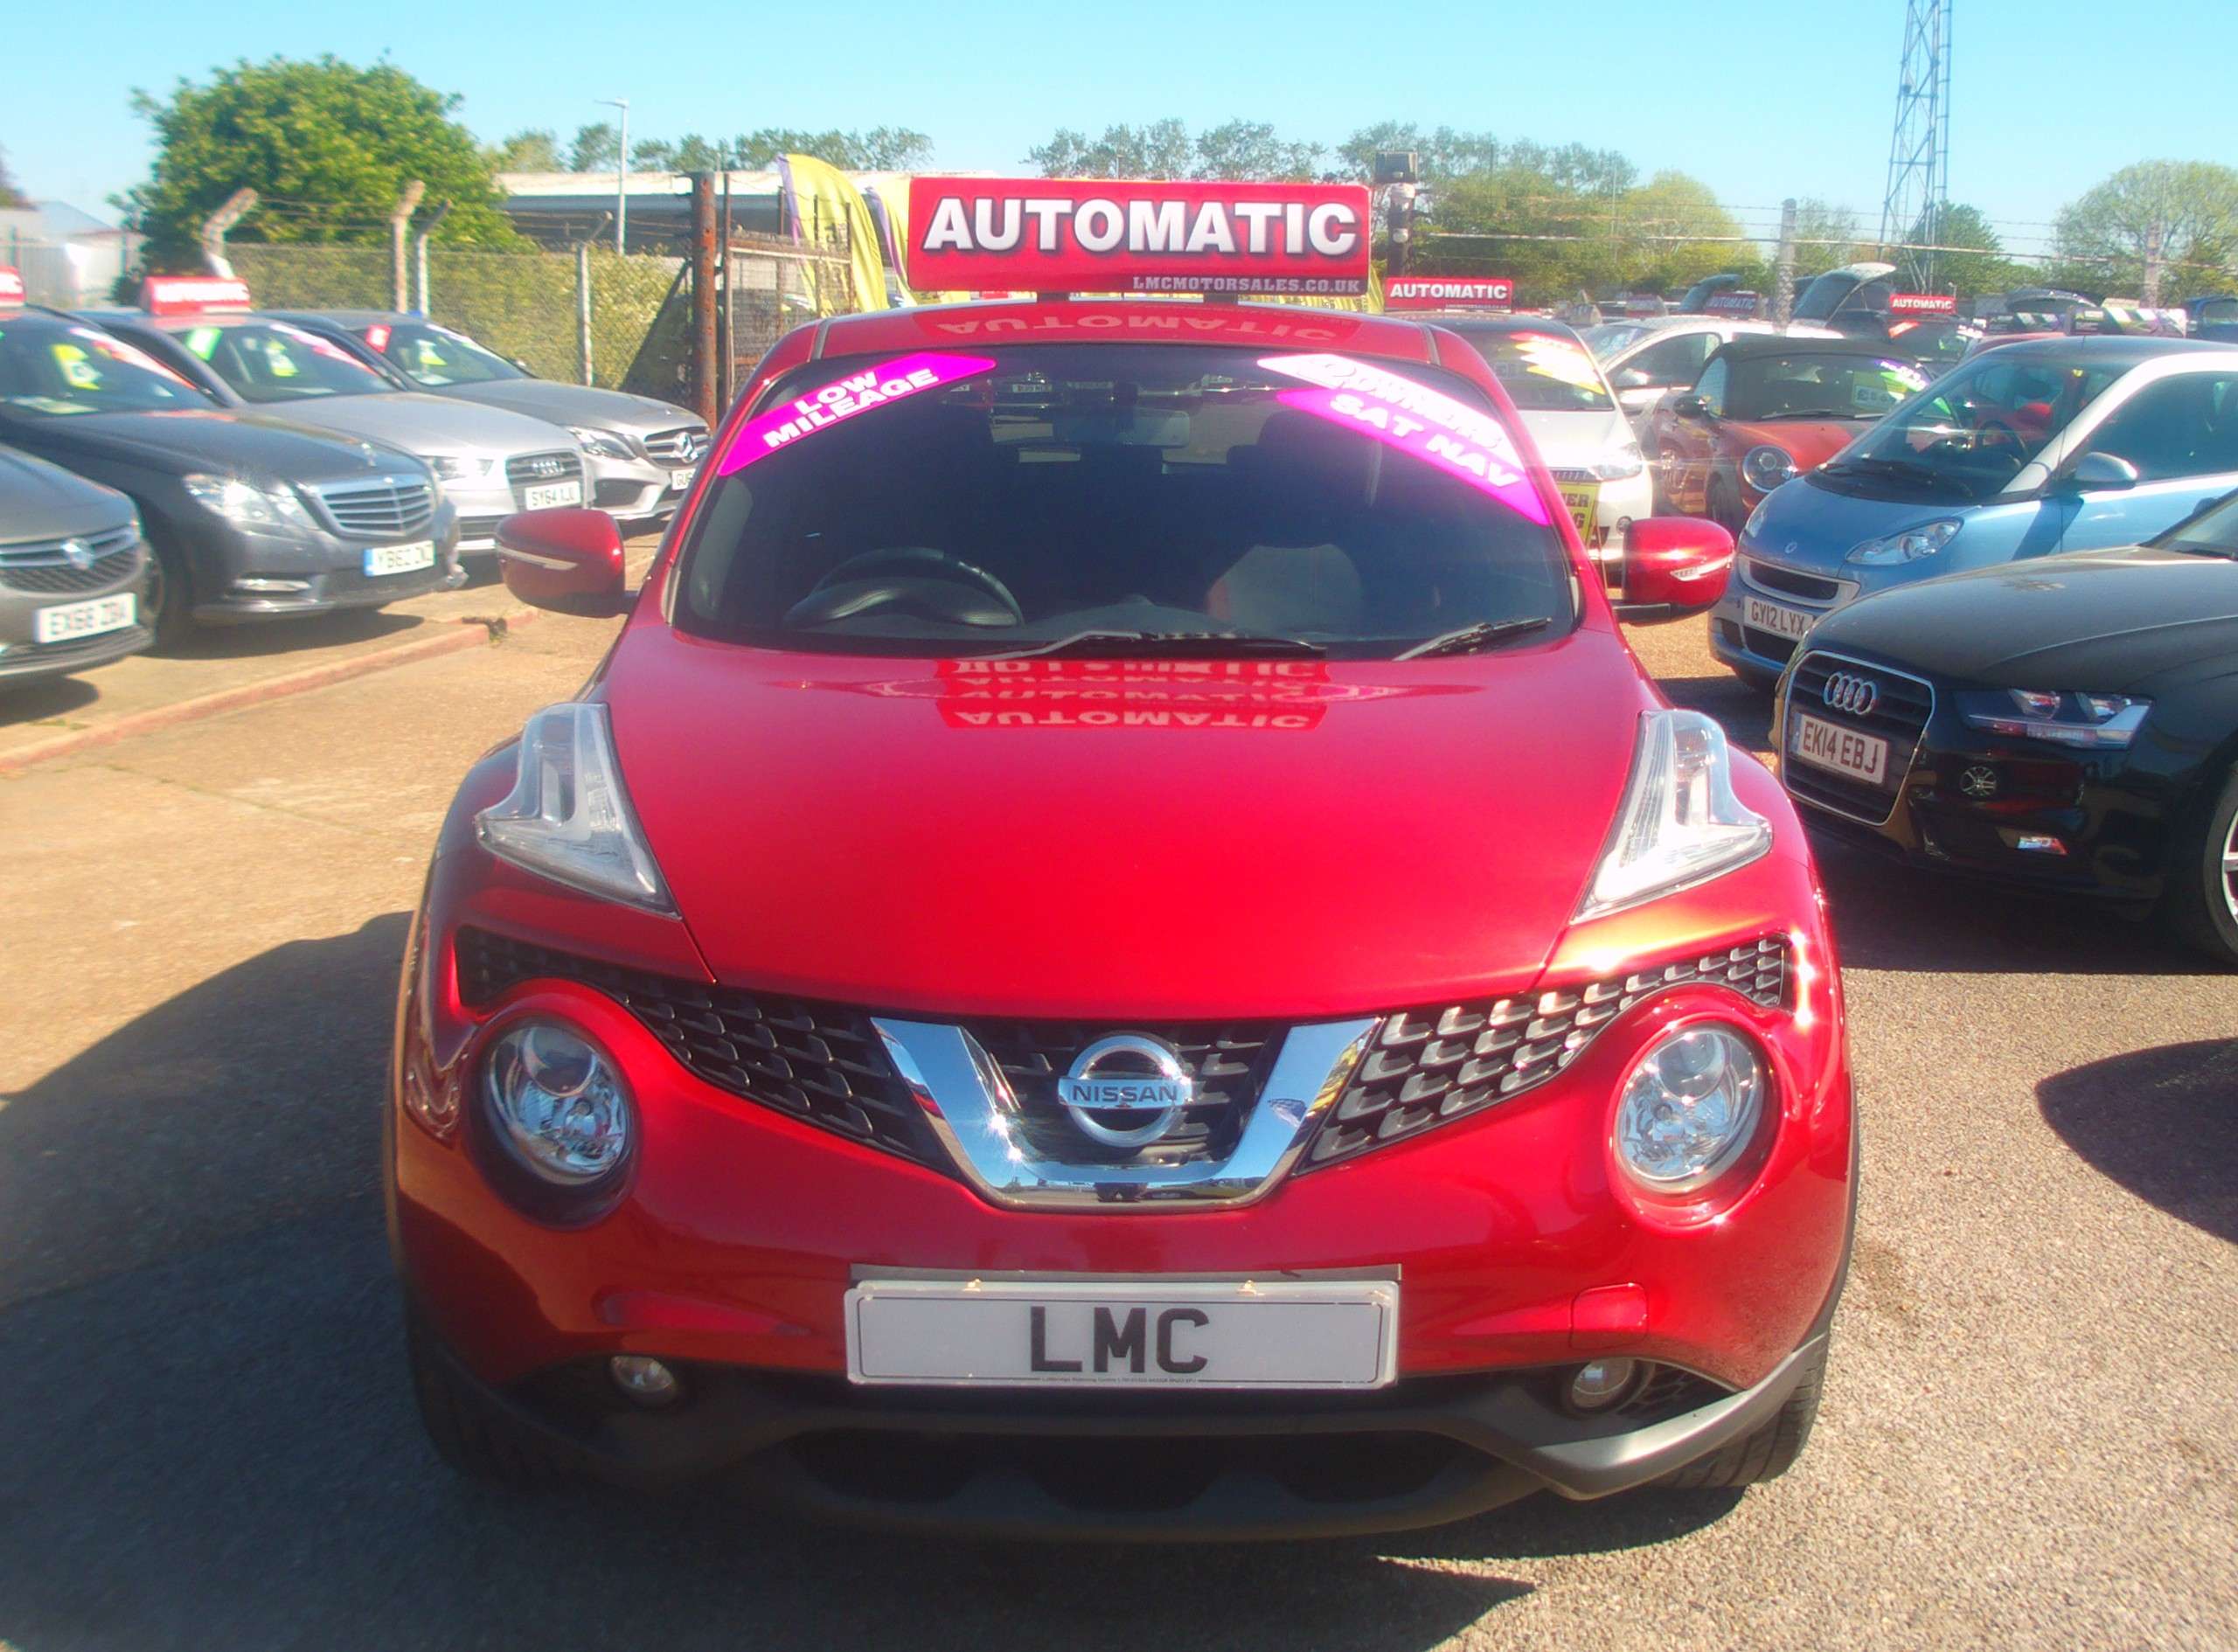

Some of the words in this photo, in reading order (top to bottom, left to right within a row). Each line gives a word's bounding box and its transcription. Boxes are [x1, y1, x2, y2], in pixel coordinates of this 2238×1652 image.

[922, 198, 1356, 255] AUTOMATIC
[1133, 276, 1359, 293] LMCMOTORSALES.CO.UK
[1390, 283, 1507, 299] AUTOMATIC
[1893, 298, 1953, 309] AUTOMATIC
[762, 368, 939, 448] MILEAGE
[794, 371, 877, 414] LOW
[1330, 394, 1425, 437] SAT
[1426, 434, 1521, 487] NAV
[1751, 601, 1777, 628] GY12
[1780, 610, 1805, 636] LYX
[1803, 721, 1838, 760] EK14
[1840, 733, 1879, 774] EBJ
[1072, 1085, 1178, 1102] NISSAN
[1030, 1306, 1209, 1373] LMC
